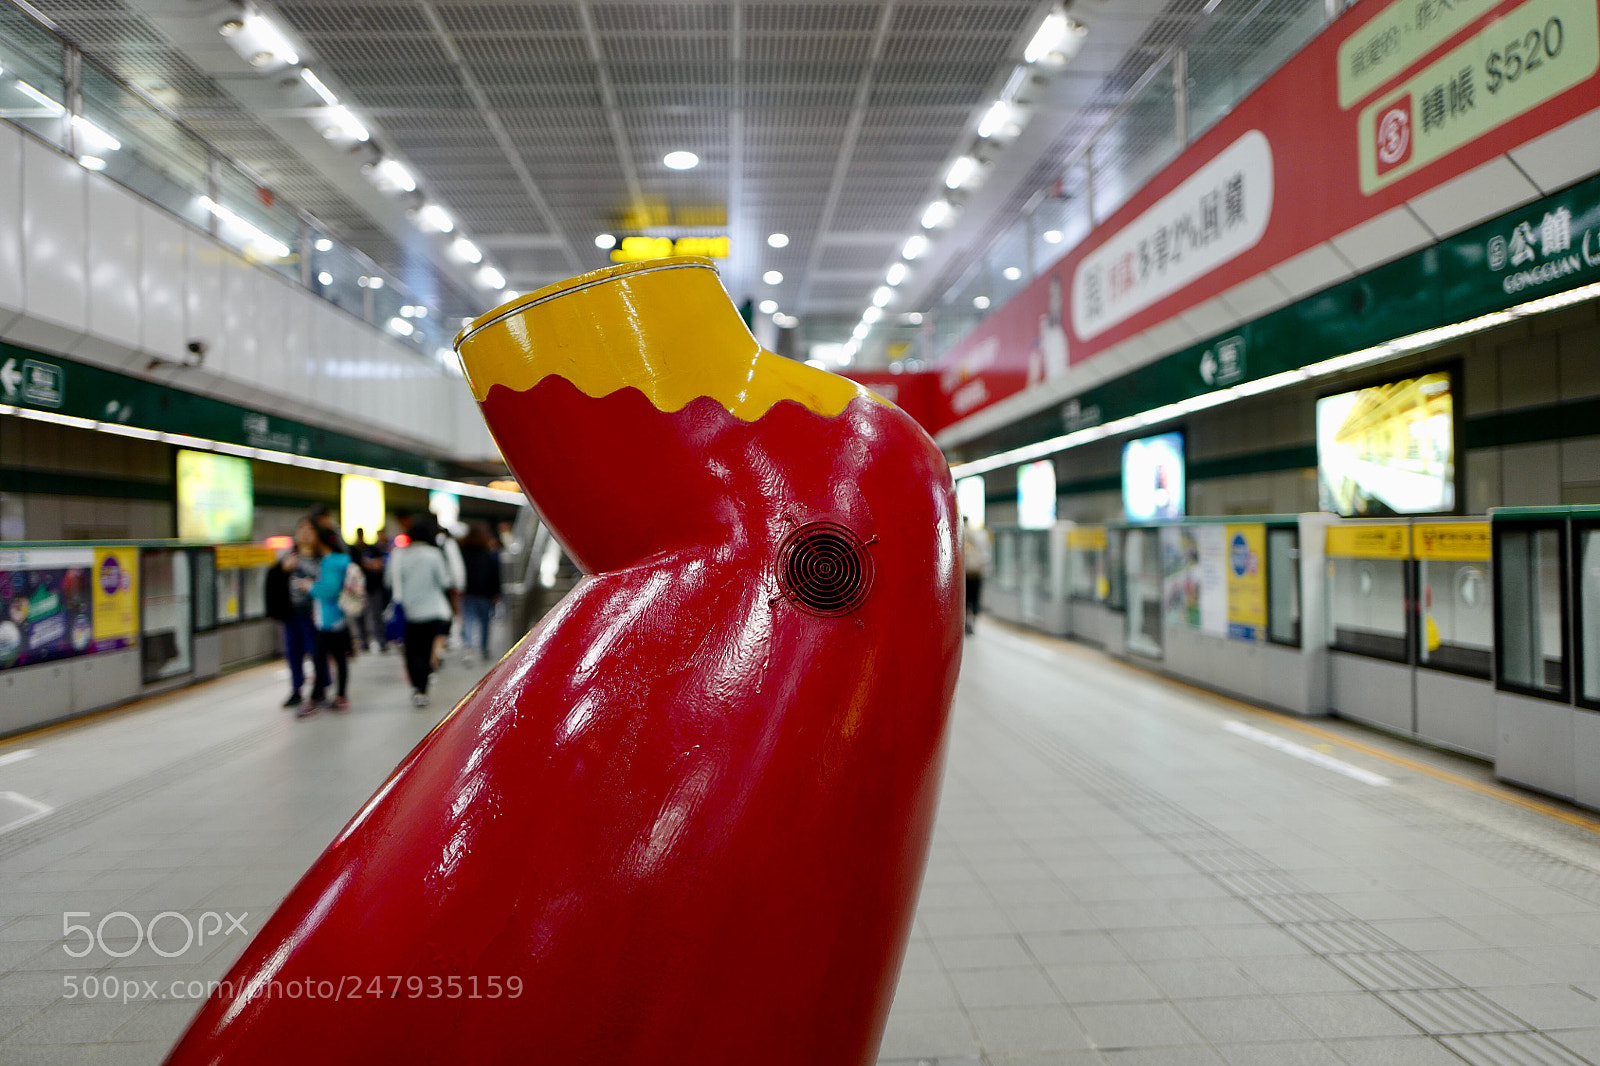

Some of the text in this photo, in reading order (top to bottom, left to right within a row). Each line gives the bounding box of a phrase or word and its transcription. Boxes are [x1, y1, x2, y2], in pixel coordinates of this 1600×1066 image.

[1486, 16, 1564, 95] $520
[1508, 206, 1572, 267] 公館
[1502, 253, 1582, 295] GONGGUAN
